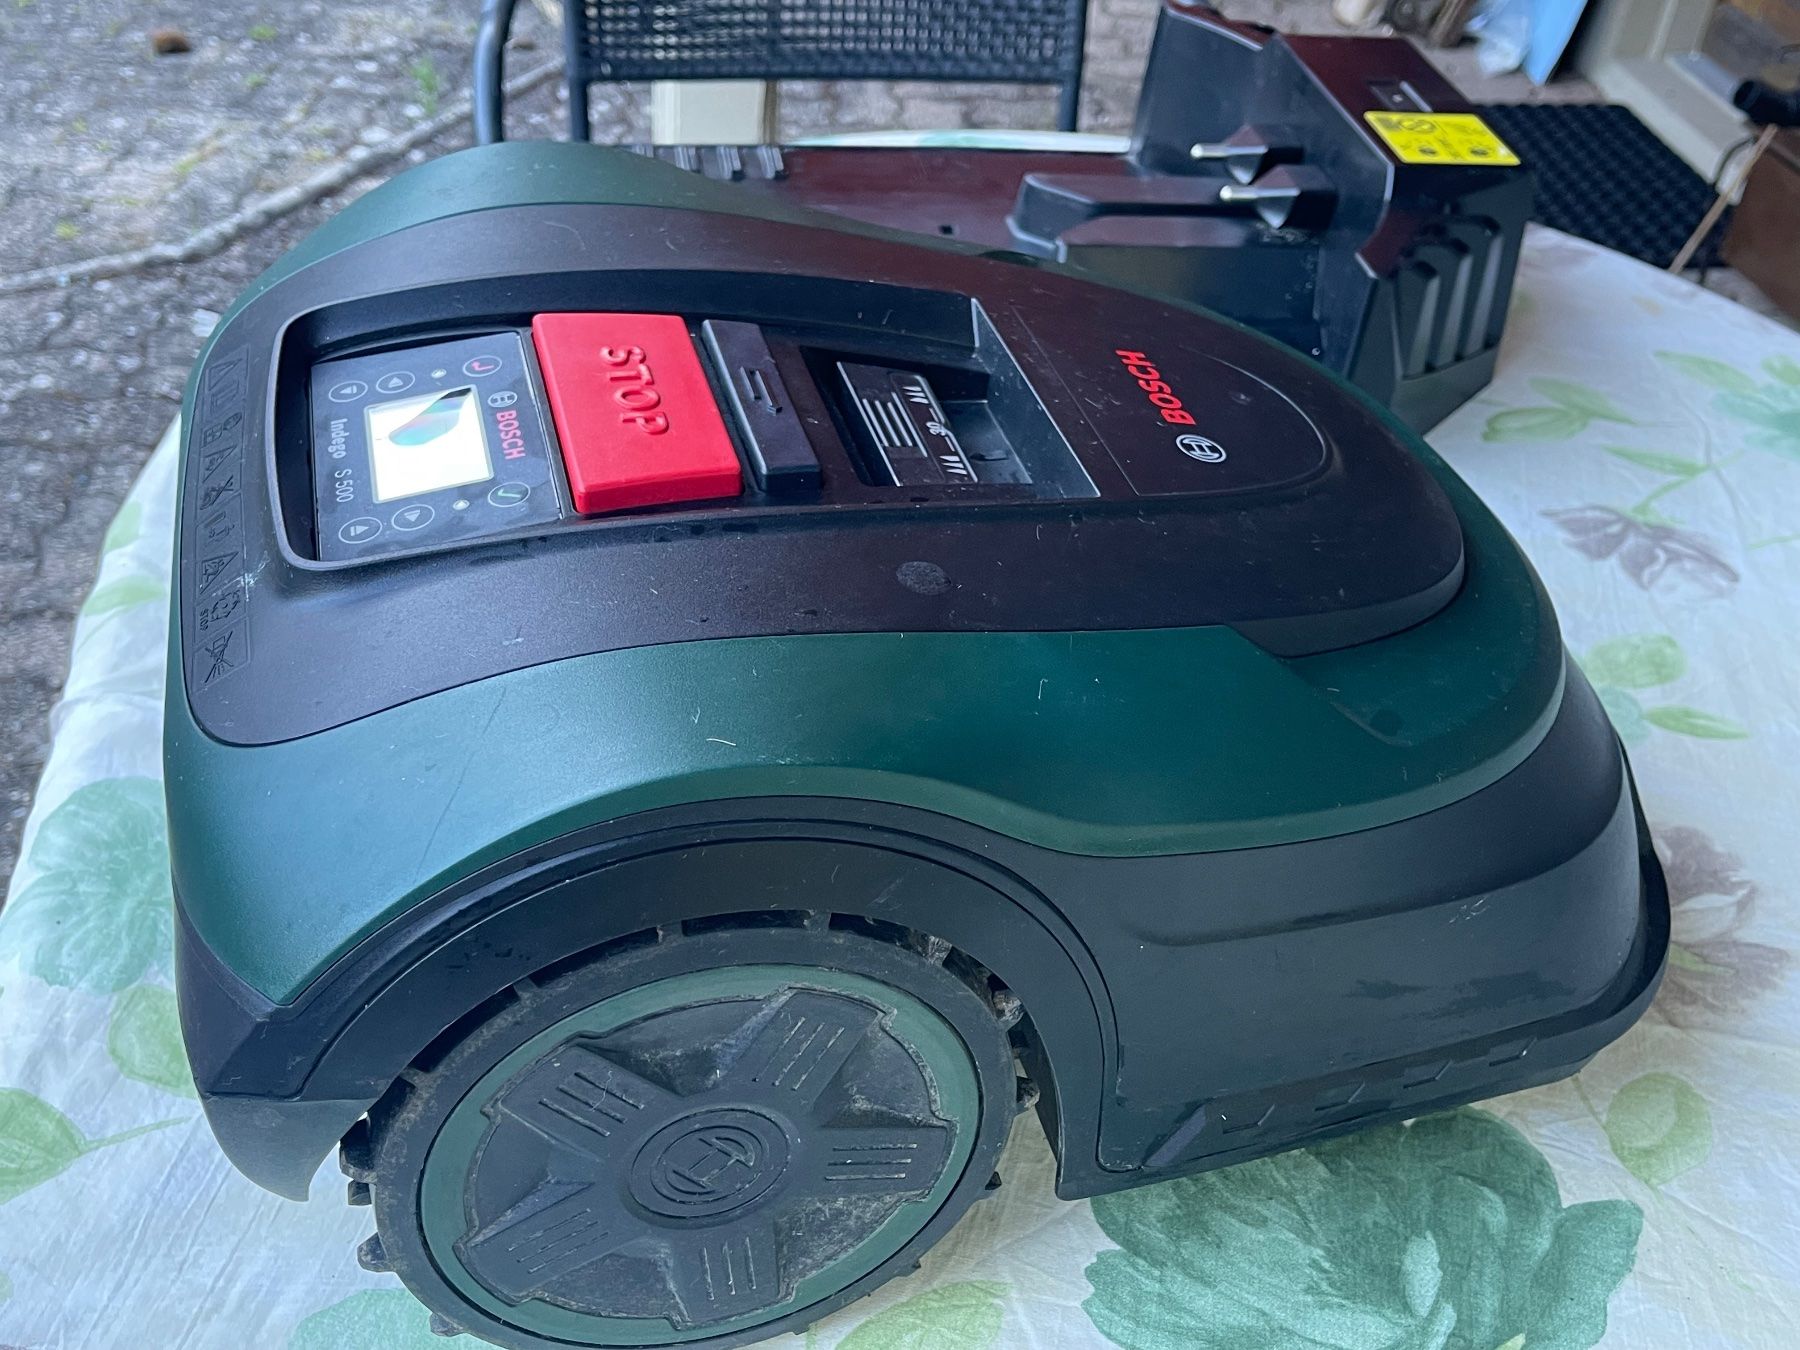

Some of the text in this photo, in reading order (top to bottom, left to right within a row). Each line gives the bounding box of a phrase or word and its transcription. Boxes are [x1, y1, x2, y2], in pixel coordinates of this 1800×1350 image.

[601, 346, 669, 434] STOP
[1115, 350, 1197, 425] BOSCH
[328, 417, 350, 459] Indego
[496, 410, 526, 460] BOSCH
